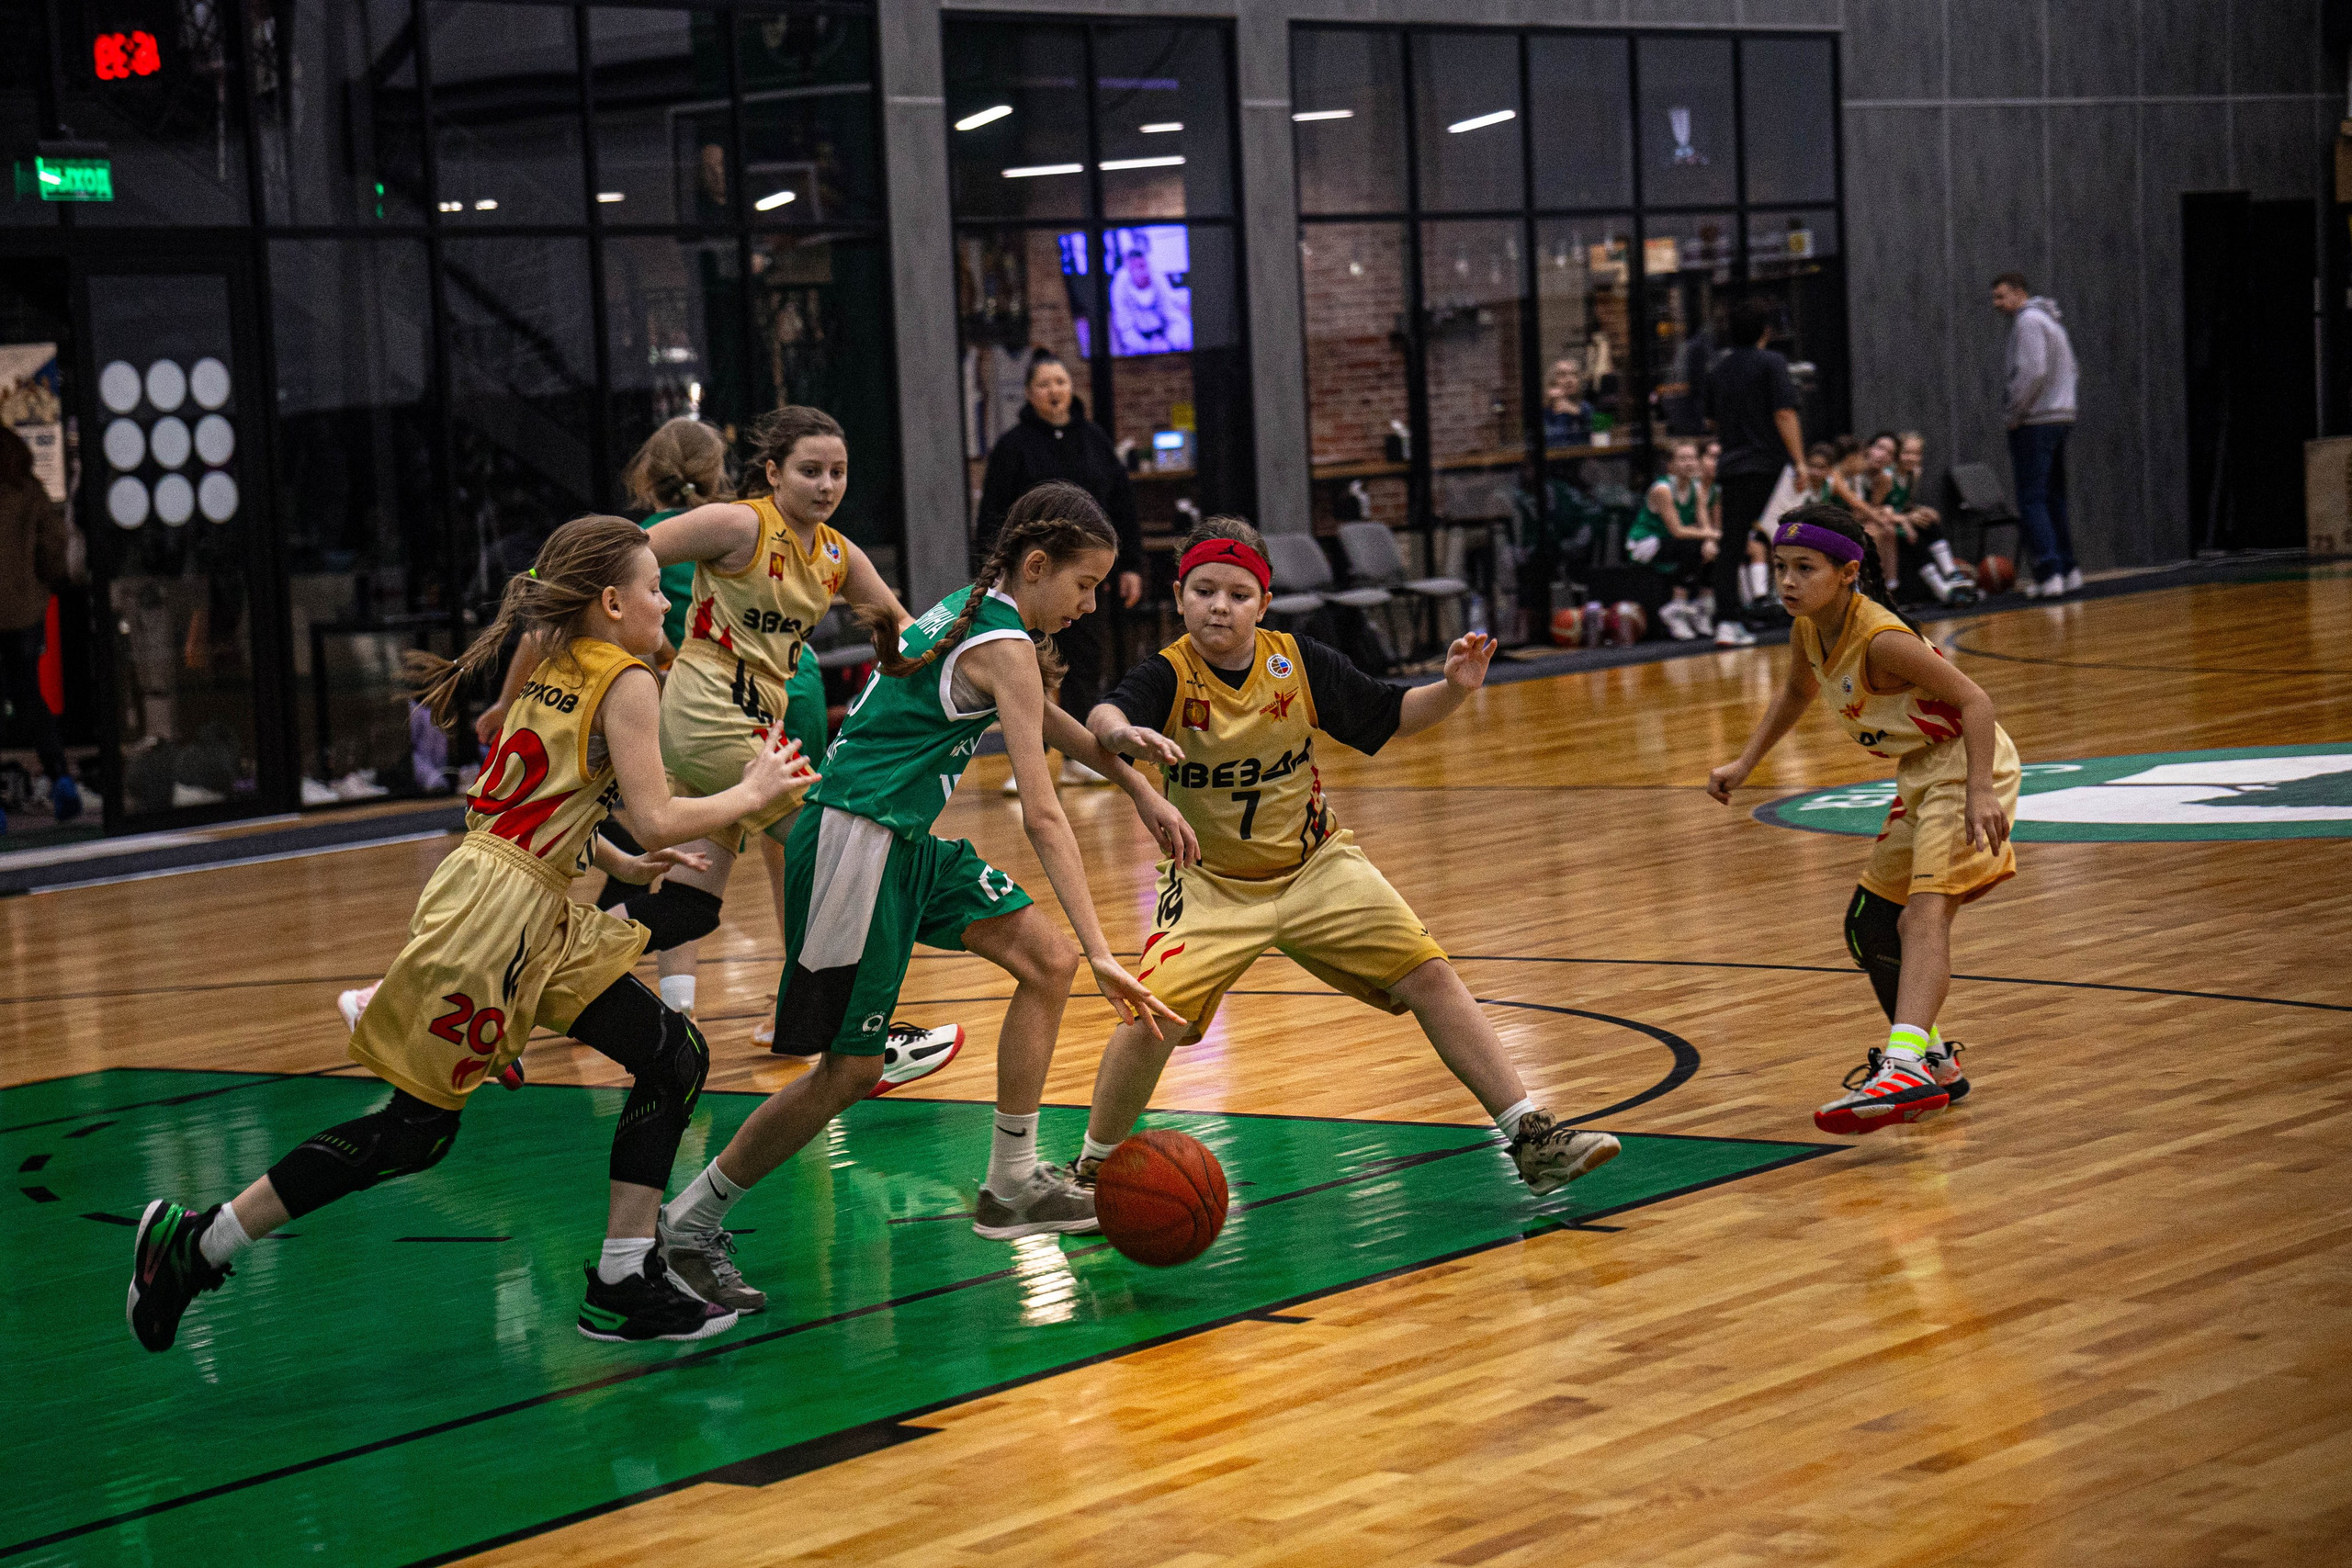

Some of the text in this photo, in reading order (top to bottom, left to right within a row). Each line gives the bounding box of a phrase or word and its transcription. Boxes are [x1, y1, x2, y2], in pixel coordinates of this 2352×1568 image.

[467, 727, 549, 816] 0
[1231, 790, 1261, 840] 7
[428, 992, 505, 1055] 20
